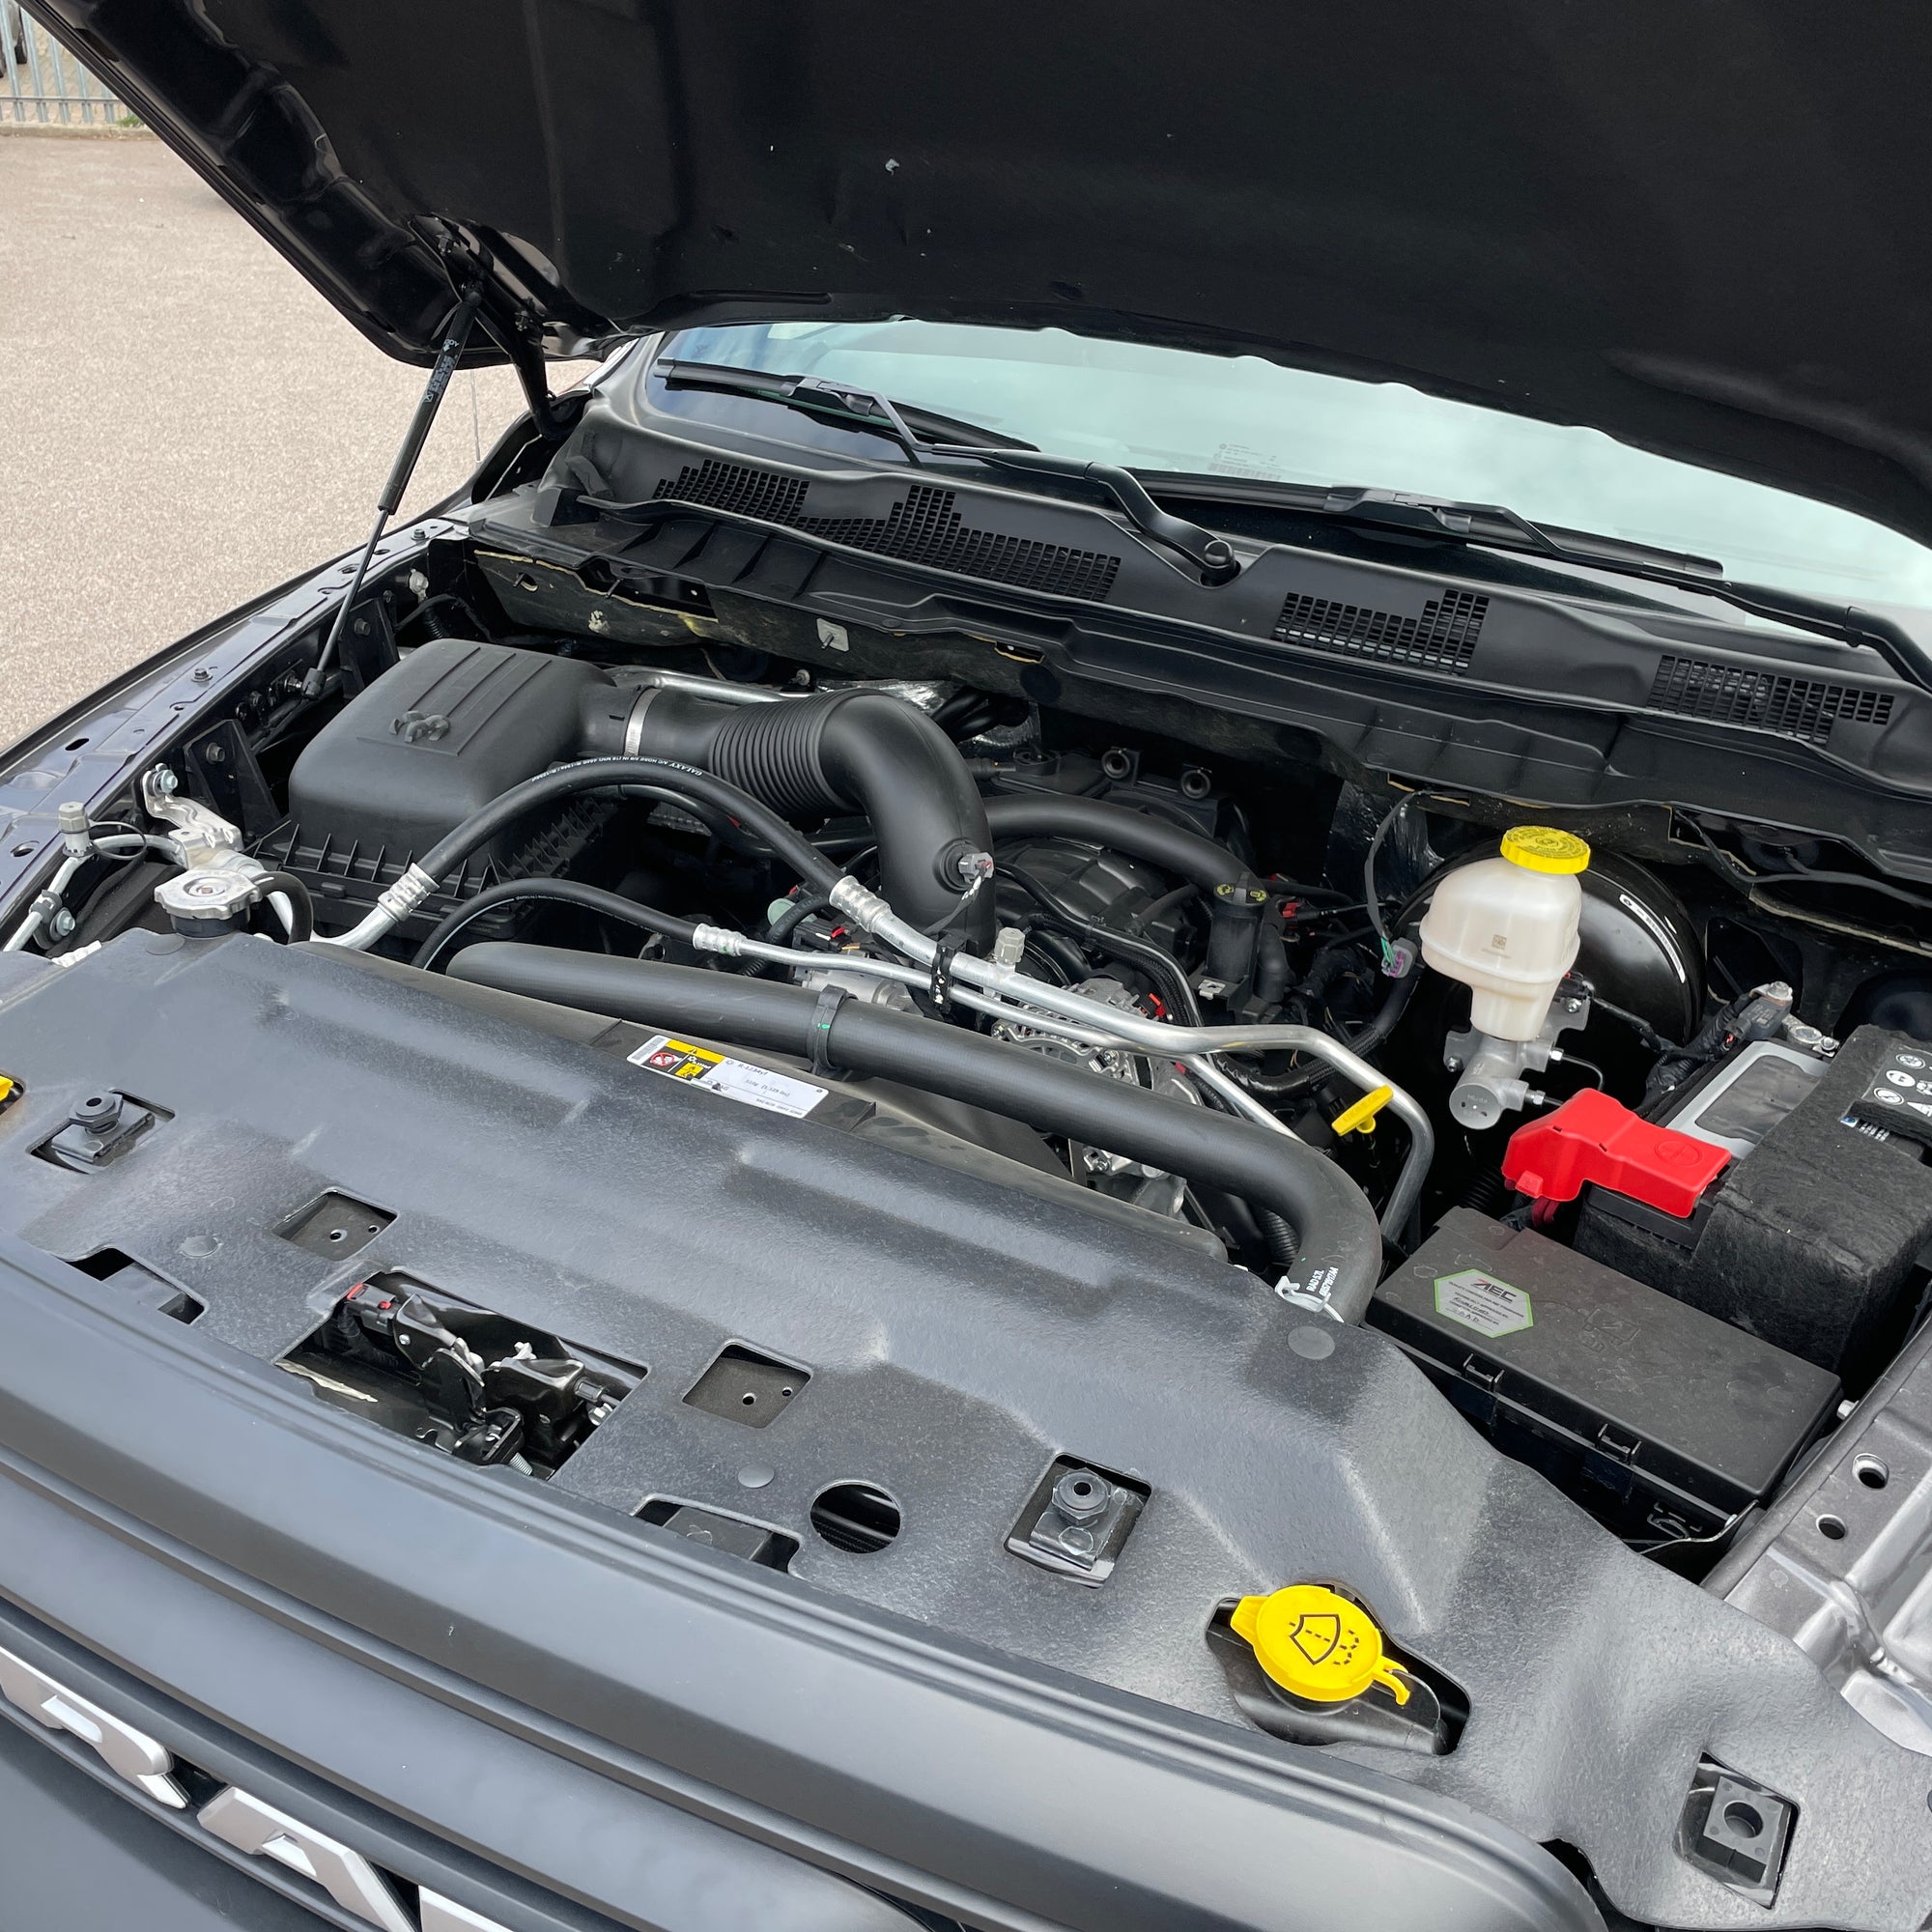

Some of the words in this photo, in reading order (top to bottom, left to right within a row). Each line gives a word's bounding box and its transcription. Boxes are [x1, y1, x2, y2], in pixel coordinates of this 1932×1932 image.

[669, 762, 703, 777] GALAXY
[1306, 1278, 1320, 1293] RAD
[1474, 1278, 1517, 1302] AEC
